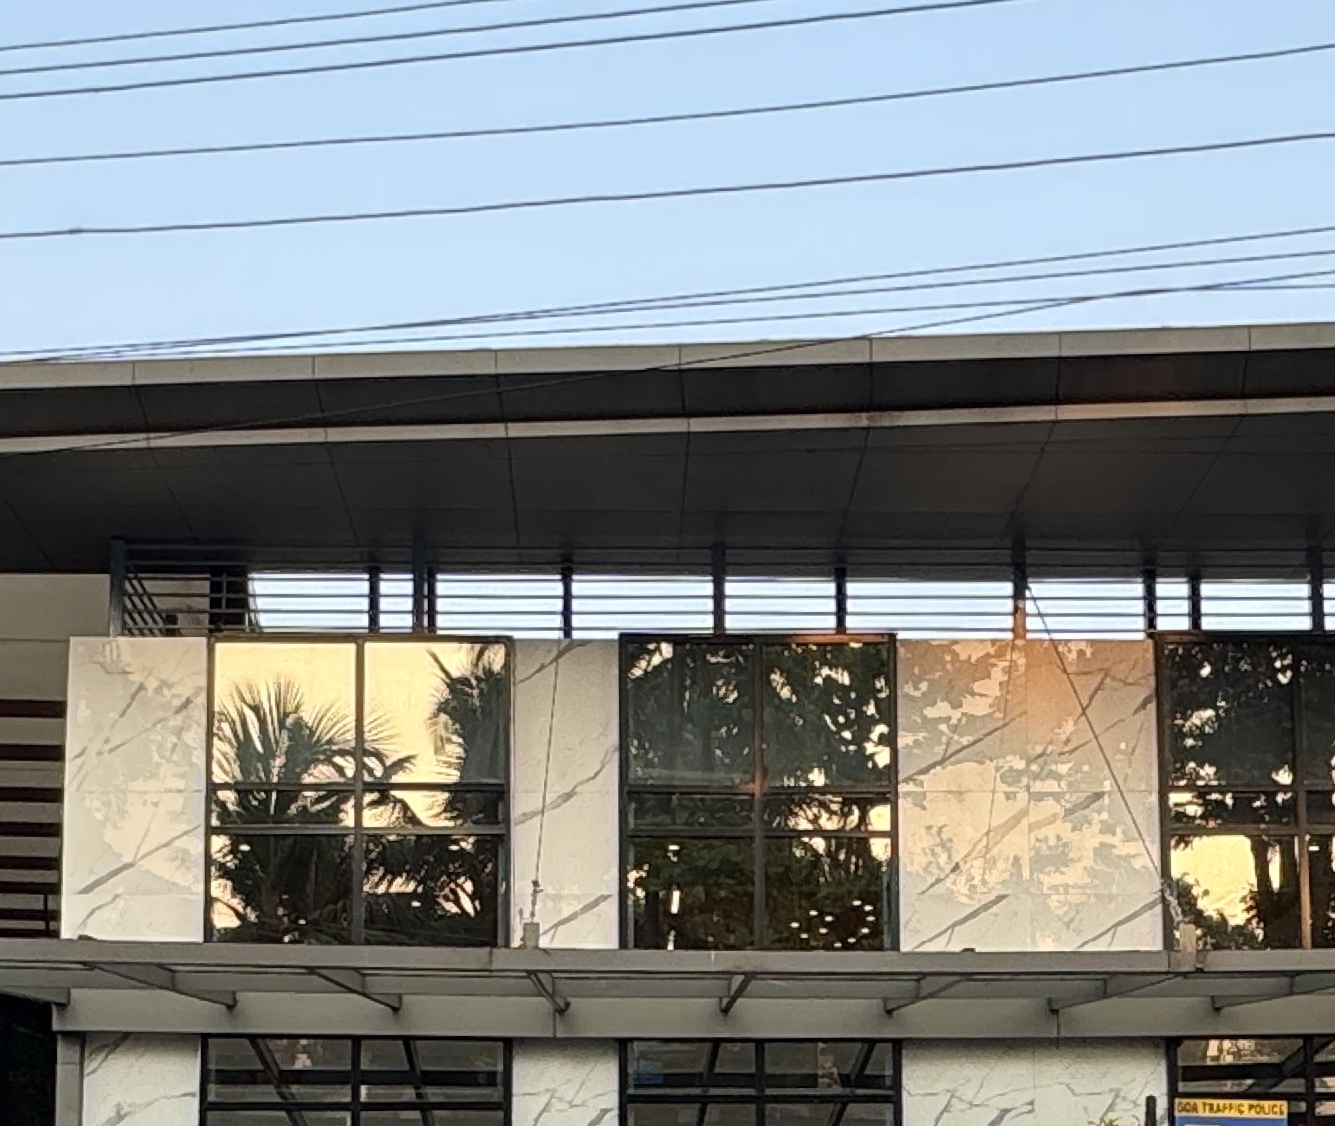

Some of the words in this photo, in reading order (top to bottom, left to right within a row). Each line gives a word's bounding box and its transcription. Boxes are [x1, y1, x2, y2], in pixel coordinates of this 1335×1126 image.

[1176, 1101, 1199, 1114] GOA
[1202, 1101, 1245, 1115] TRAFFIC
[1248, 1103, 1285, 1116] POLICE
